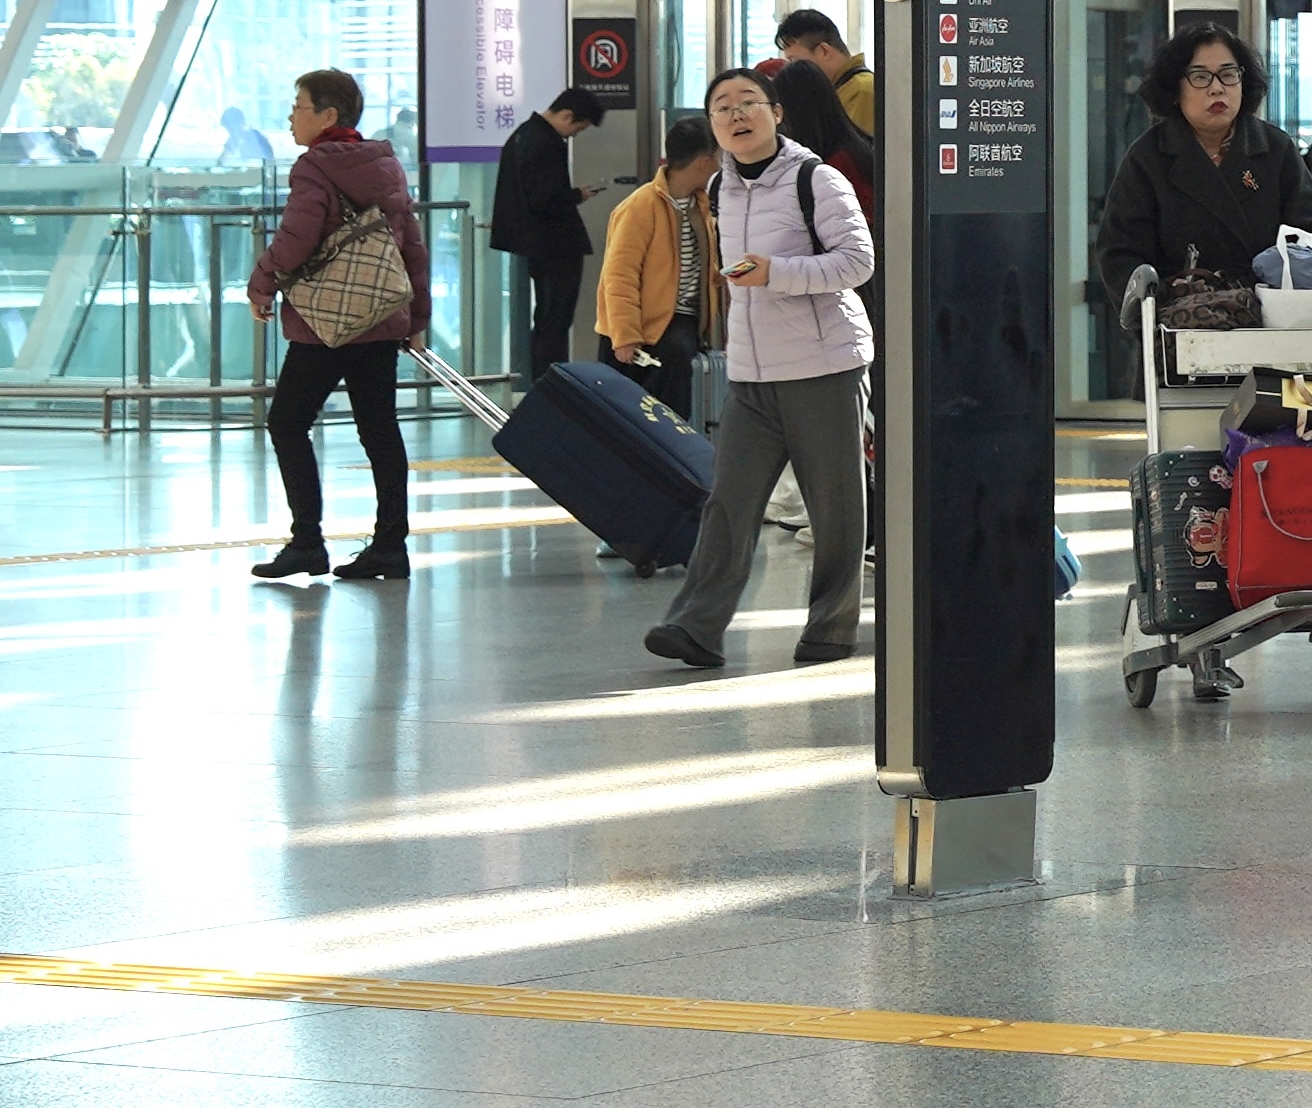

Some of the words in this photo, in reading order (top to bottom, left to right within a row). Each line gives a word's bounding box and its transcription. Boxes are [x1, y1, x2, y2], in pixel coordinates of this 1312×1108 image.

[968, 17, 1009, 34] 亚洲航空
[968, 37, 979, 46] Air
[980, 36, 994, 46] Asia
[968, 55, 1025, 74] 新加坡航空
[968, 76, 1006, 90] Singapore
[1008, 76, 1034, 88] Airlines
[475, 66, 487, 131] Elevator
[968, 98, 1025, 118] 全日空航空
[968, 121, 979, 132] All
[980, 121, 1006, 135] Nippon
[1007, 122, 1037, 135] Airways
[968, 165, 1004, 177] Emirates
